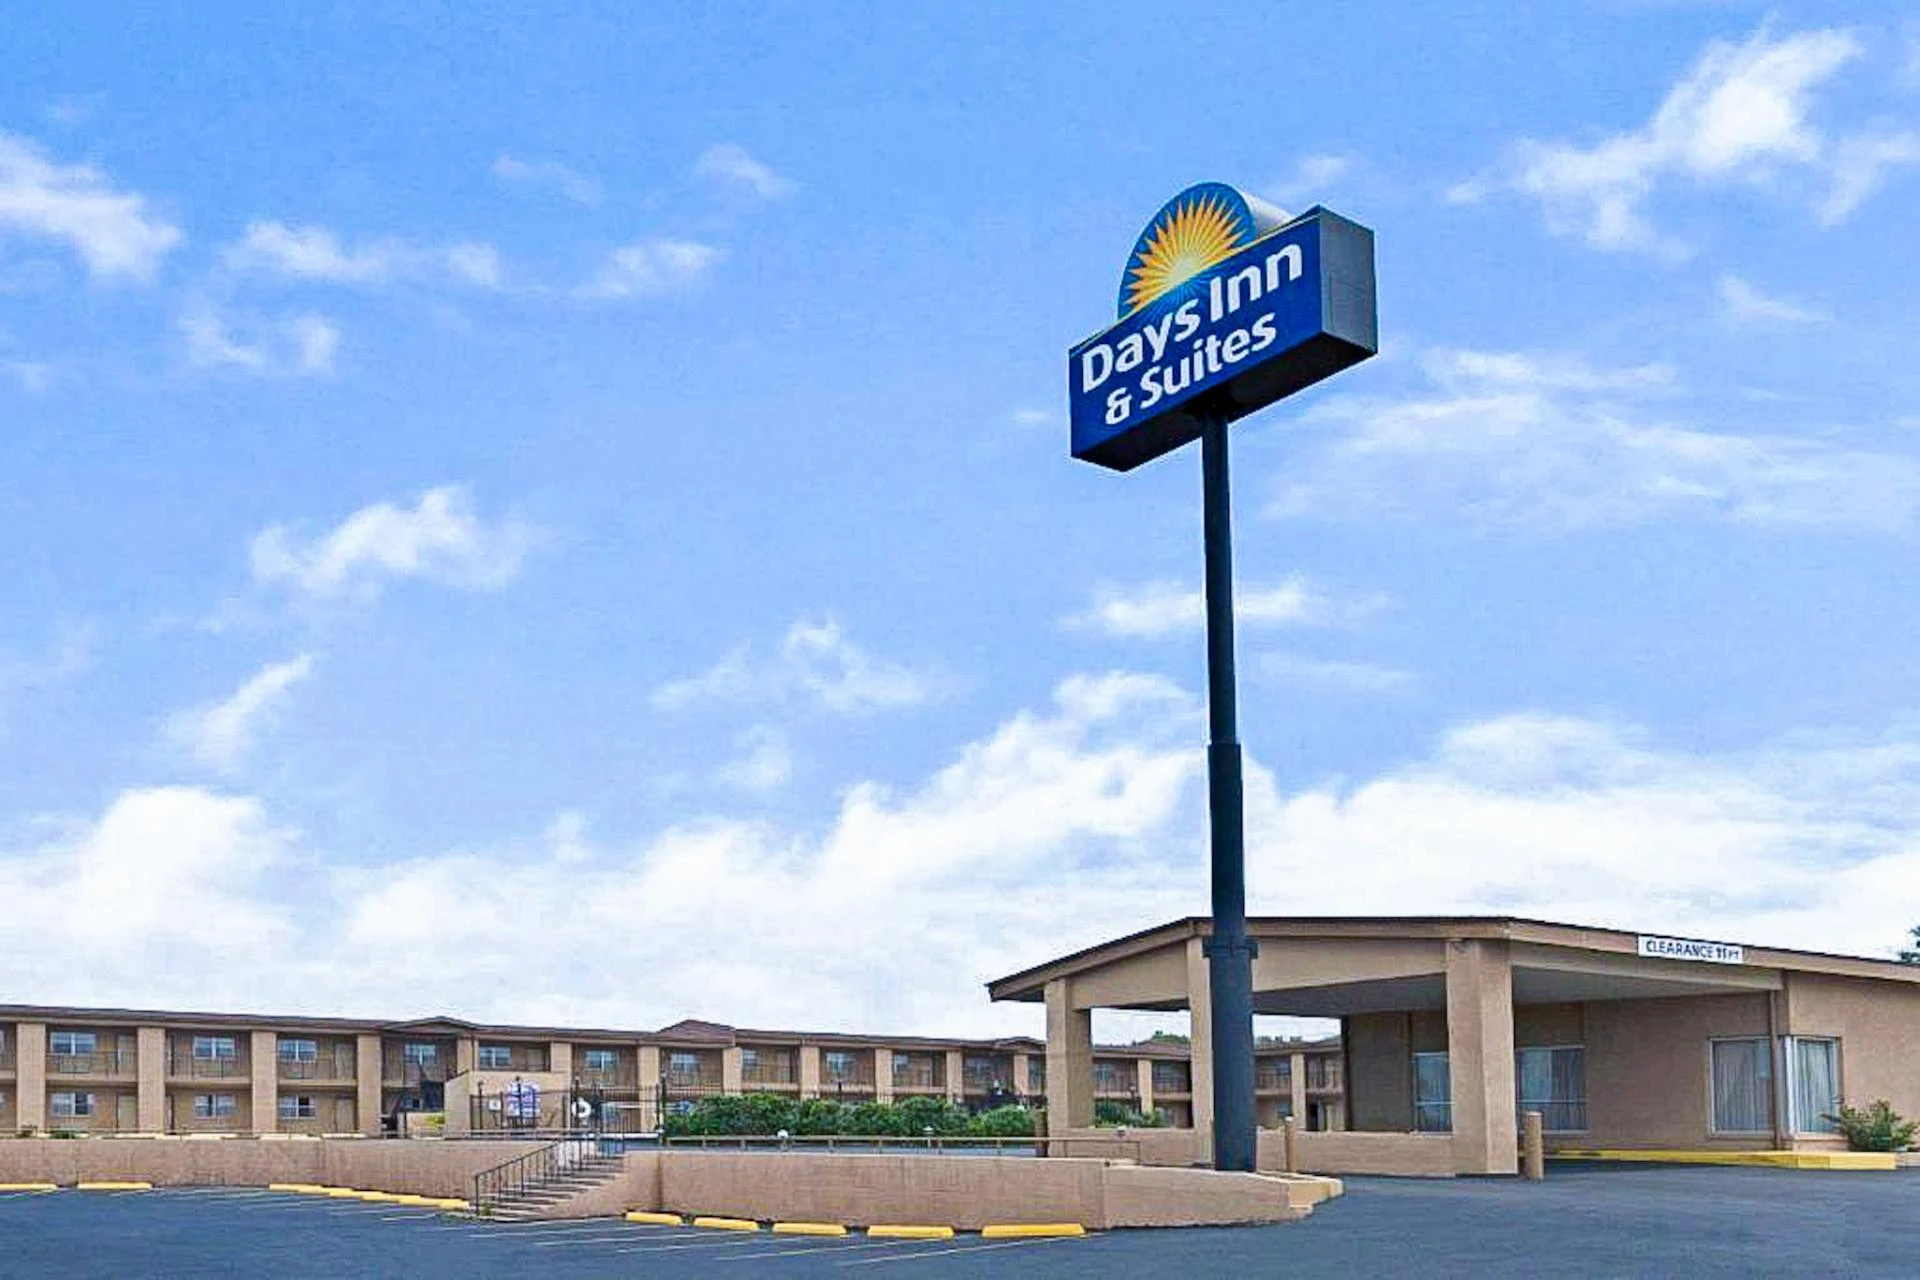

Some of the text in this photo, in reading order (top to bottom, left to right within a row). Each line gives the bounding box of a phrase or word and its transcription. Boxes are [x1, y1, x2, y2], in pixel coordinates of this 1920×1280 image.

[1081, 244, 1302, 393] Days Inn
[1105, 312, 1277, 425] & Suites
[1646, 939, 1713, 958] CLEARANCE
